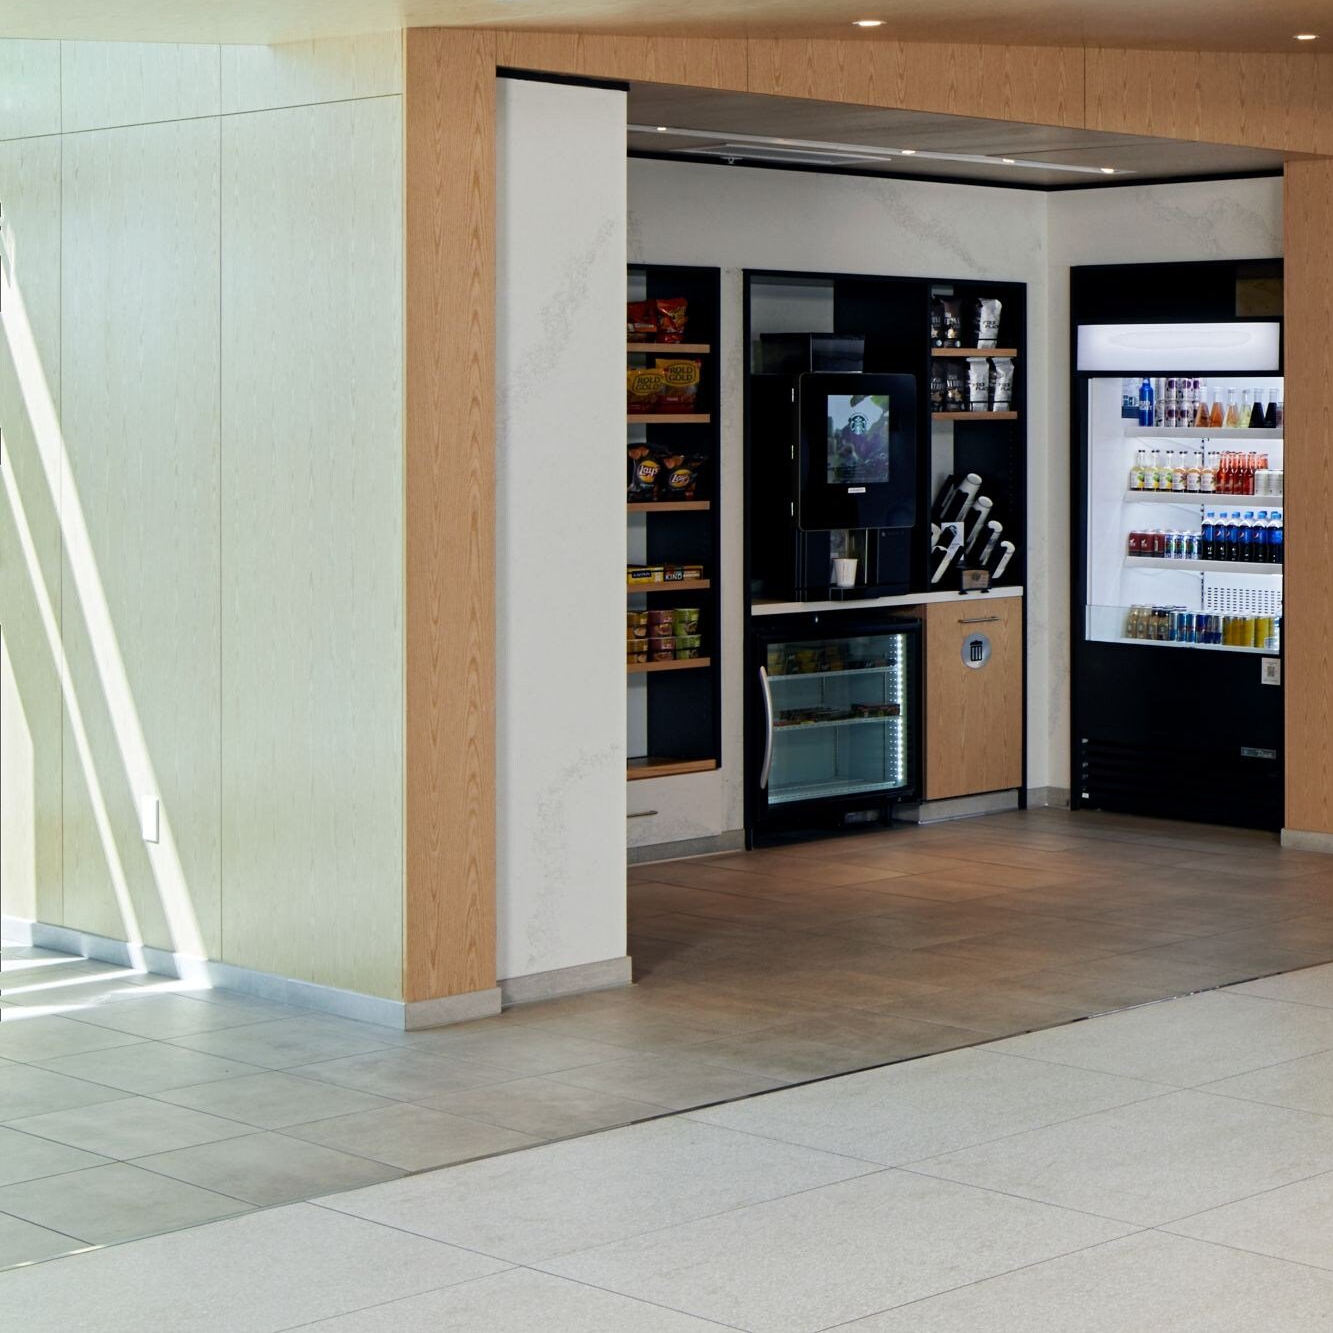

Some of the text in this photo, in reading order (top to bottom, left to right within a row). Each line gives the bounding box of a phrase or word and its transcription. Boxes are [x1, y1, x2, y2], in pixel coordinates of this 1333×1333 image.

[670, 366, 693, 374] ROLD
[637, 376, 661, 384] ROLD
[669, 374, 693, 382] GOLD
[665, 571, 683, 580] KIND
